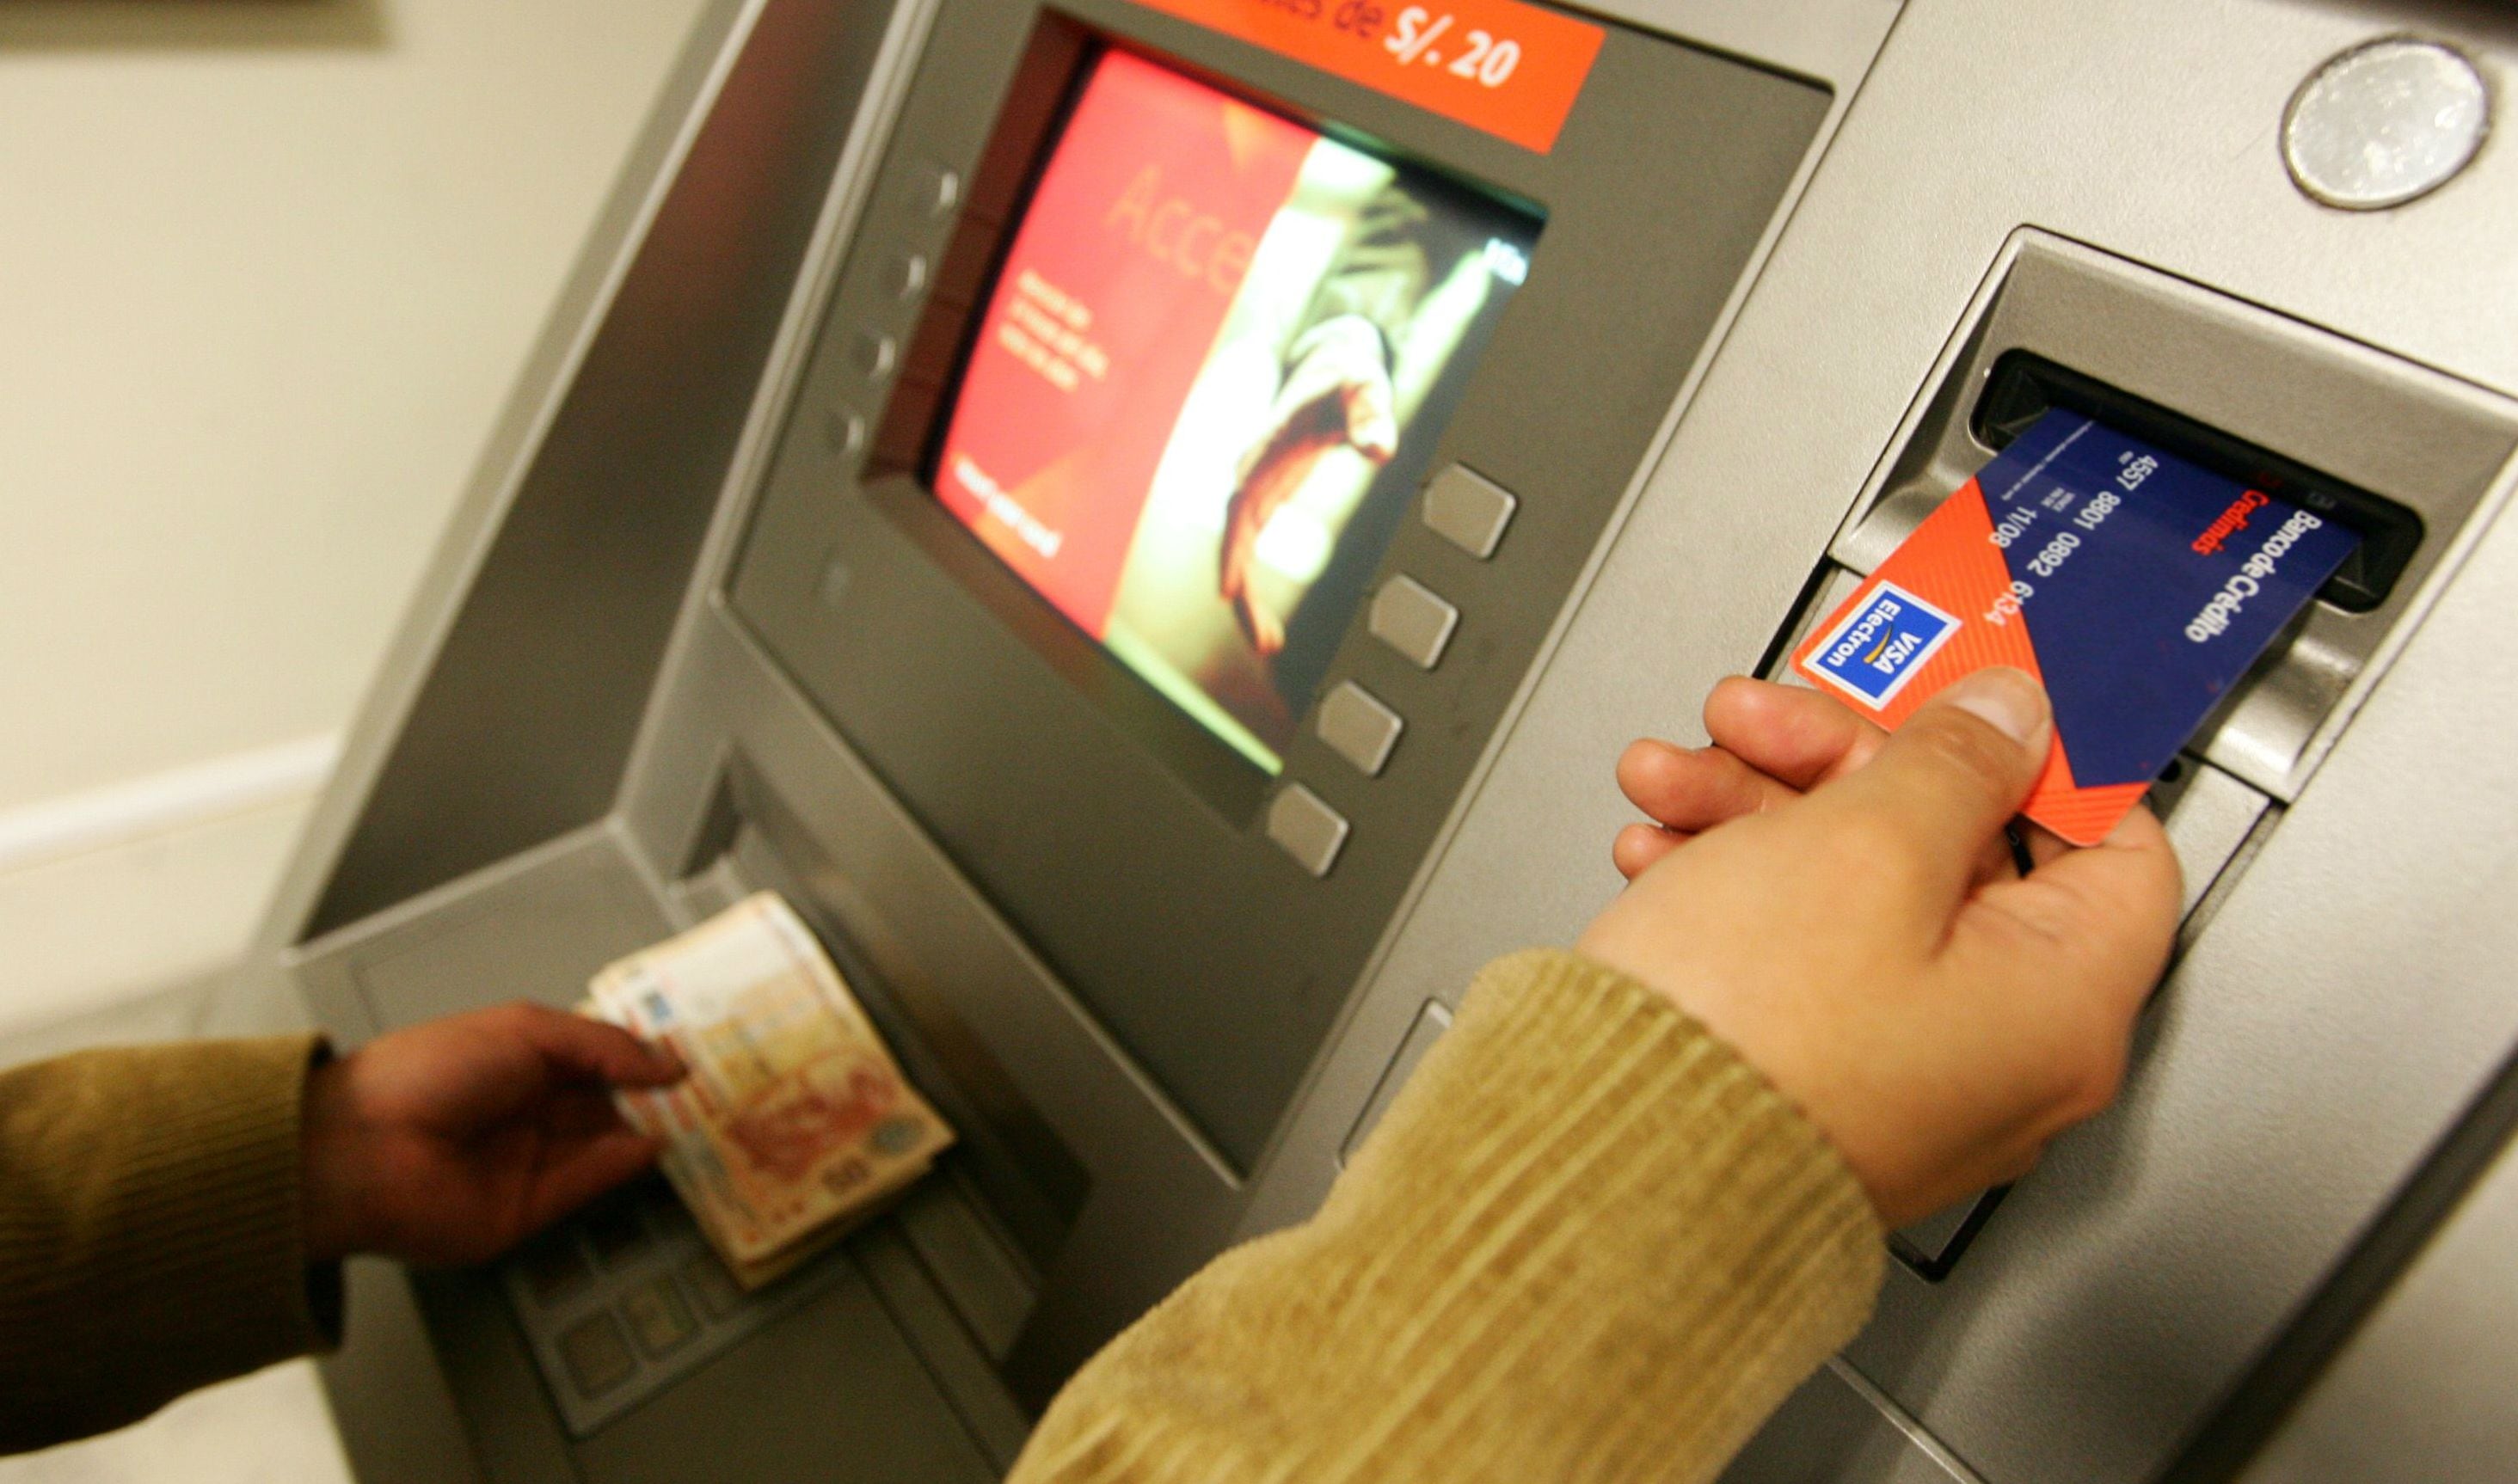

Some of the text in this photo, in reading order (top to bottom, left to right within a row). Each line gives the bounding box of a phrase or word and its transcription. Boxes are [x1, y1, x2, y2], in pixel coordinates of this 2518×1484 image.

[1384, 6, 1453, 65] S/.
[1448, 29, 1521, 87] 20
[2116, 454, 2159, 491] 4557
[1988, 506, 2038, 549] 11/08
[2073, 491, 2122, 530] 8801
[2190, 489, 2270, 555] Credimás
[2026, 531, 2081, 577] 0892
[2184, 509, 2323, 643] Banco de Crédito
[1982, 580, 2035, 626] 6134
[1827, 599, 1902, 667] Electron
[1872, 632, 1924, 674] VISA
